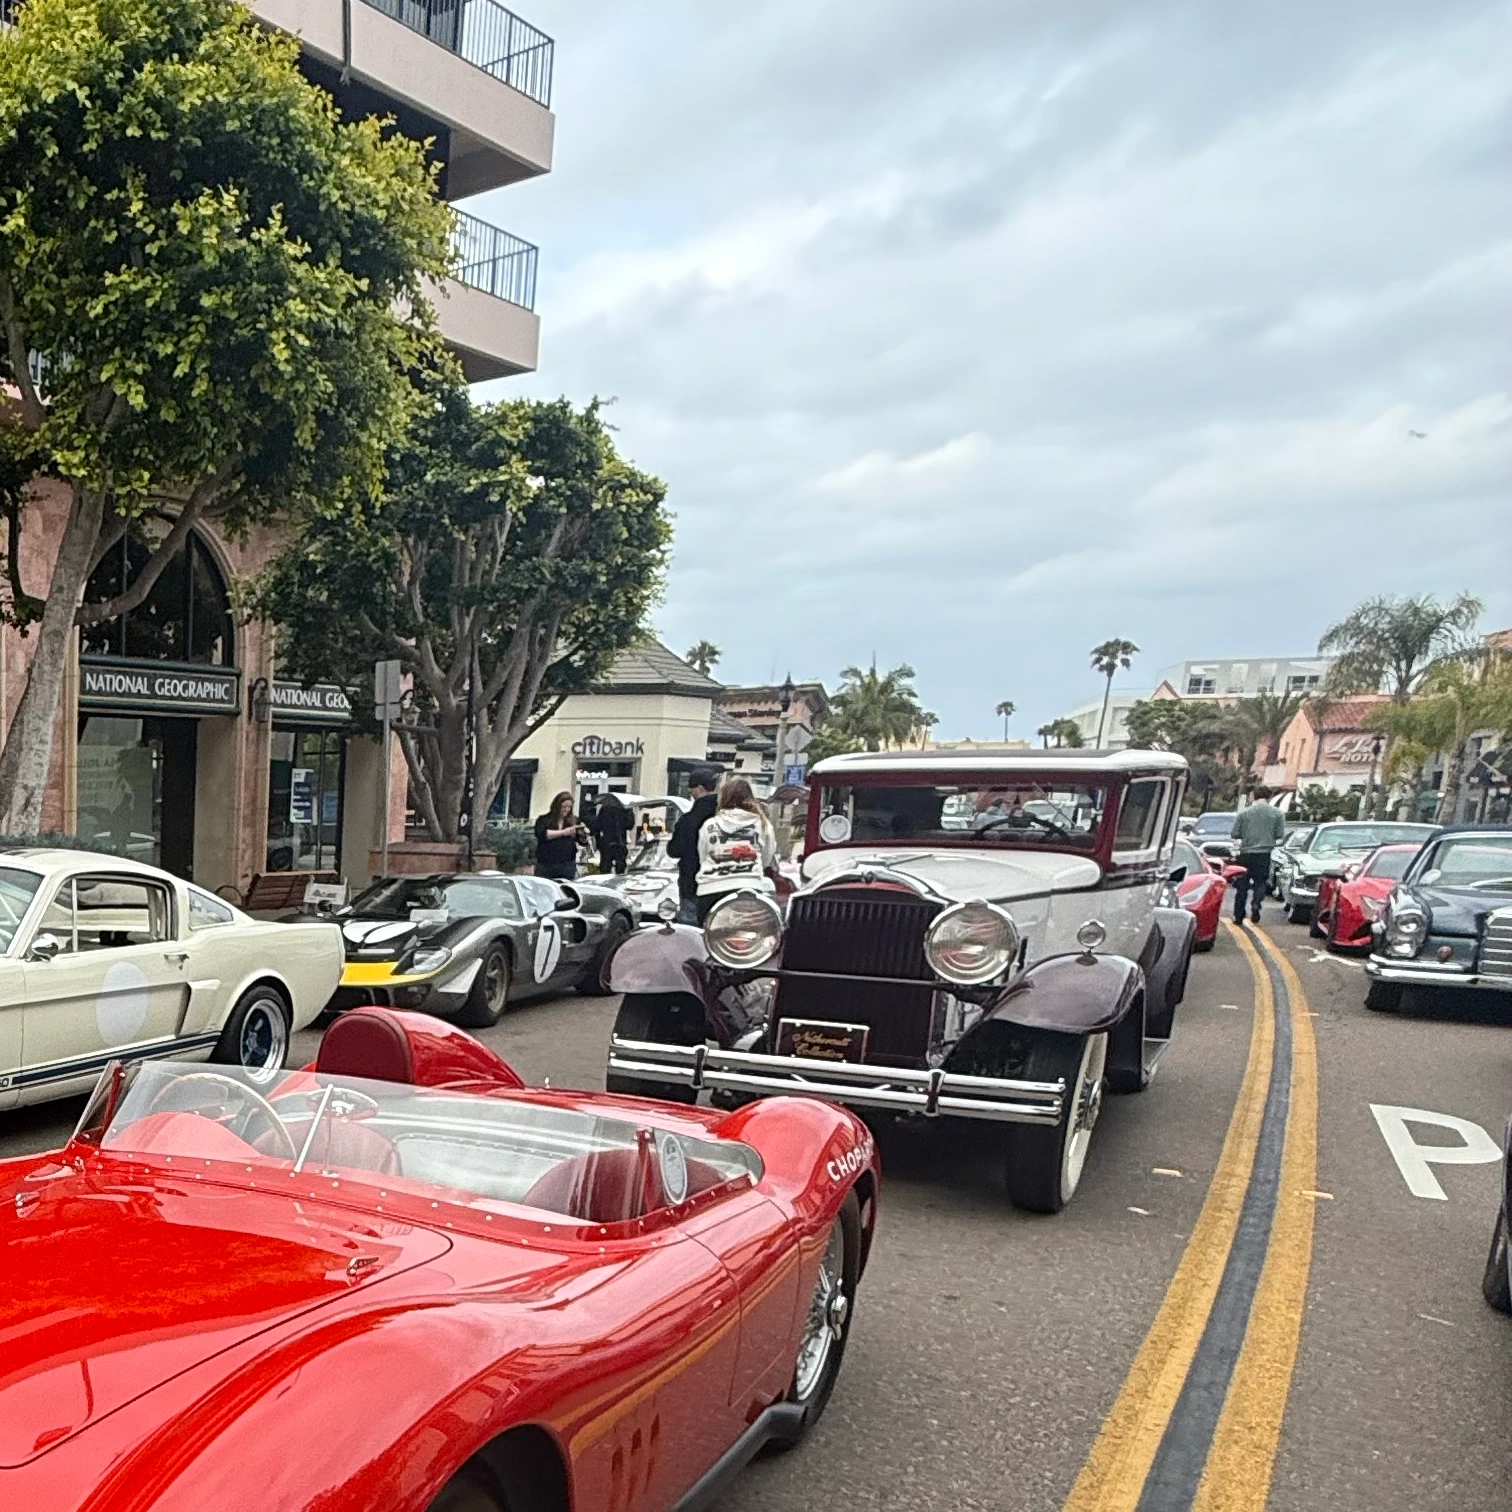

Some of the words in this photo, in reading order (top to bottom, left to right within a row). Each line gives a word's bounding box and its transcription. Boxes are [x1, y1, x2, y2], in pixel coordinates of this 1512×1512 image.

[85, 672, 151, 695] NATIONAL
[154, 677, 230, 700] GEOGRAPHIC
[270, 687, 322, 707] NATIONAL
[571, 735, 645, 756] citibank
[540, 924, 556, 978] 7
